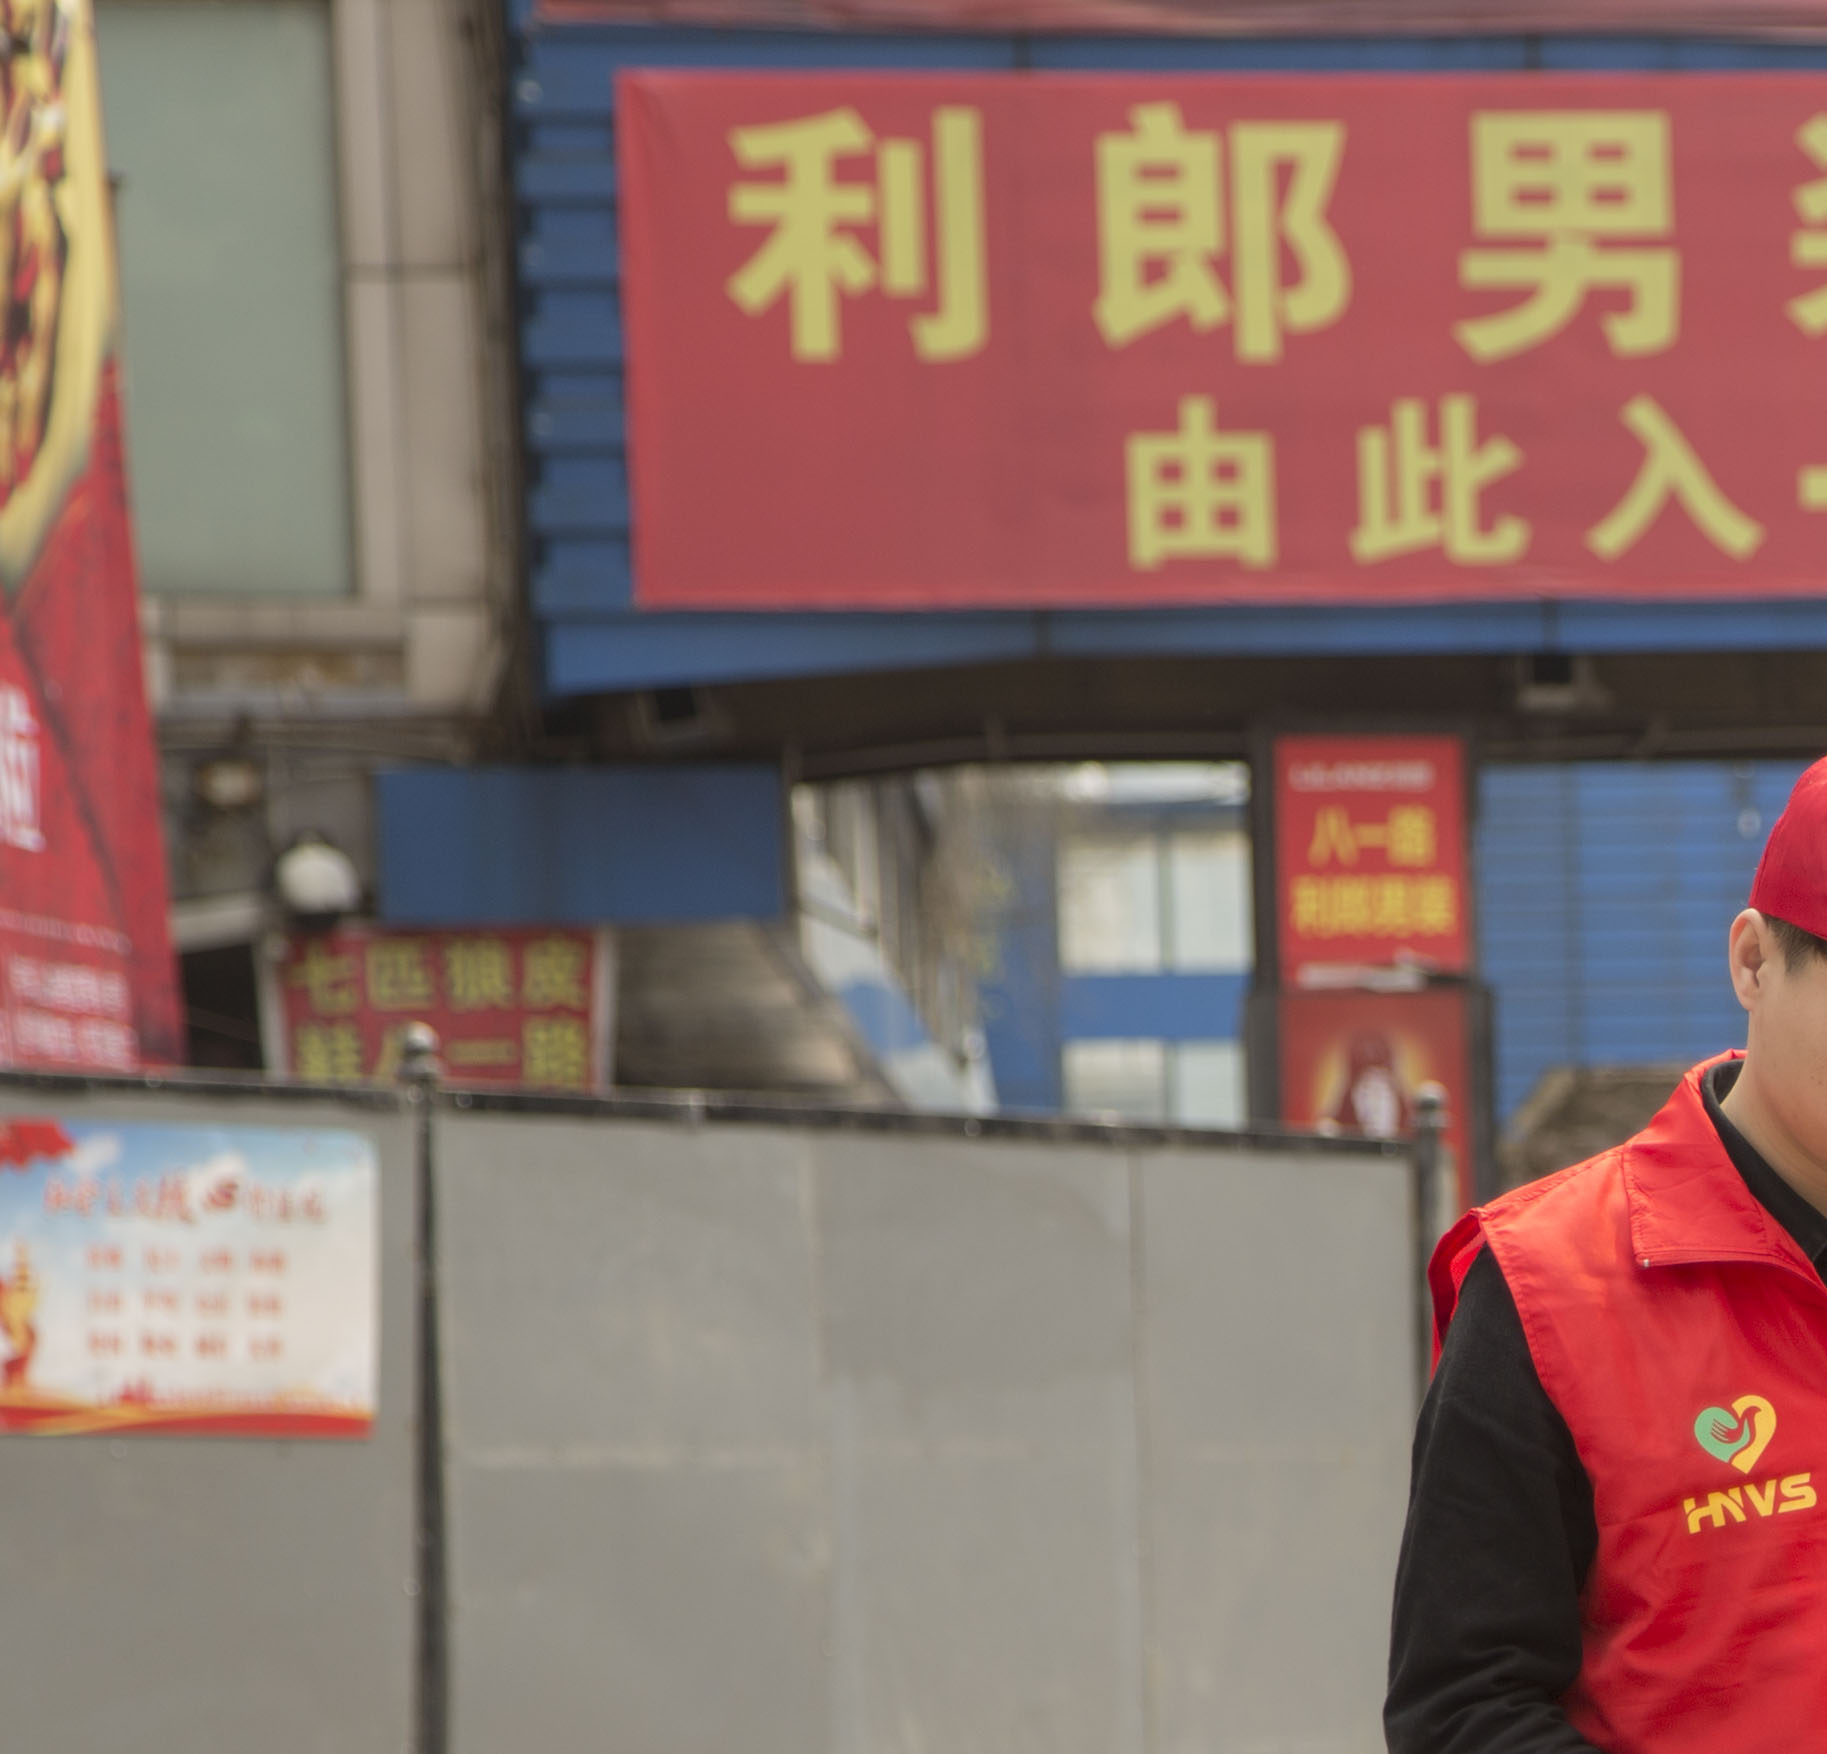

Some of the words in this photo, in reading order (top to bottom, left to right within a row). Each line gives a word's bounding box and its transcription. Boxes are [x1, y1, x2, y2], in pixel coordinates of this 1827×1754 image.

[1124, 395, 1765, 571] 由此入
[1683, 1472, 1817, 1535] HNVS
